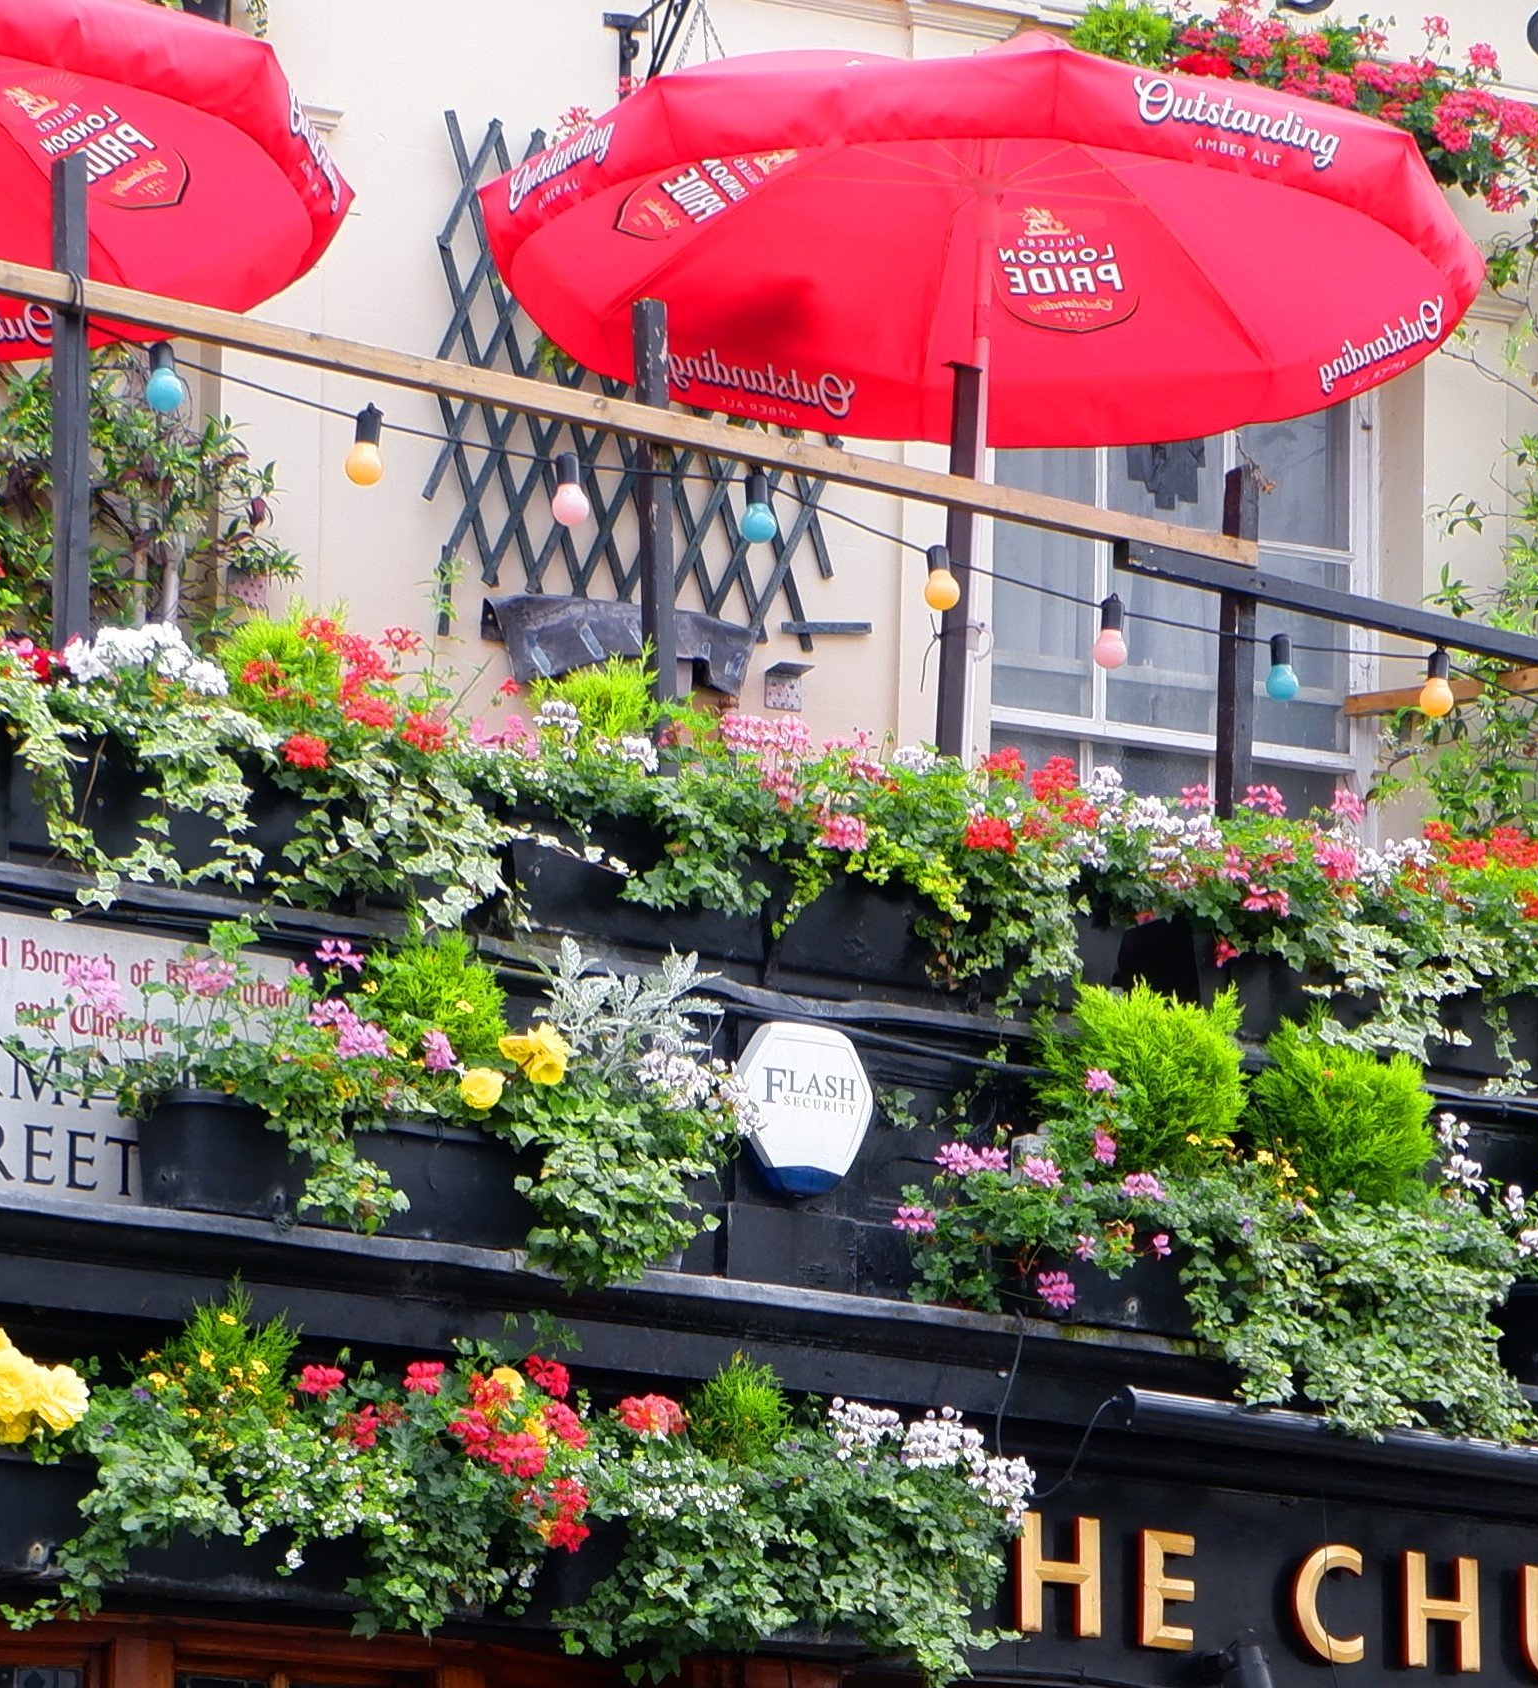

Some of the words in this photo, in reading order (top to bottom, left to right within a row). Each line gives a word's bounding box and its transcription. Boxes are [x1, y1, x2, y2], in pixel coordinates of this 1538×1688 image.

[1134, 75, 1340, 170] Outstanding
[1194, 136, 1246, 160] AMBER
[1251, 149, 1282, 167] ALE
[130, 958, 156, 987] of
[762, 1066, 856, 1104] FLASH
[783, 1095, 857, 1116] SECURITY
[1015, 1510, 1196, 1651] HE
